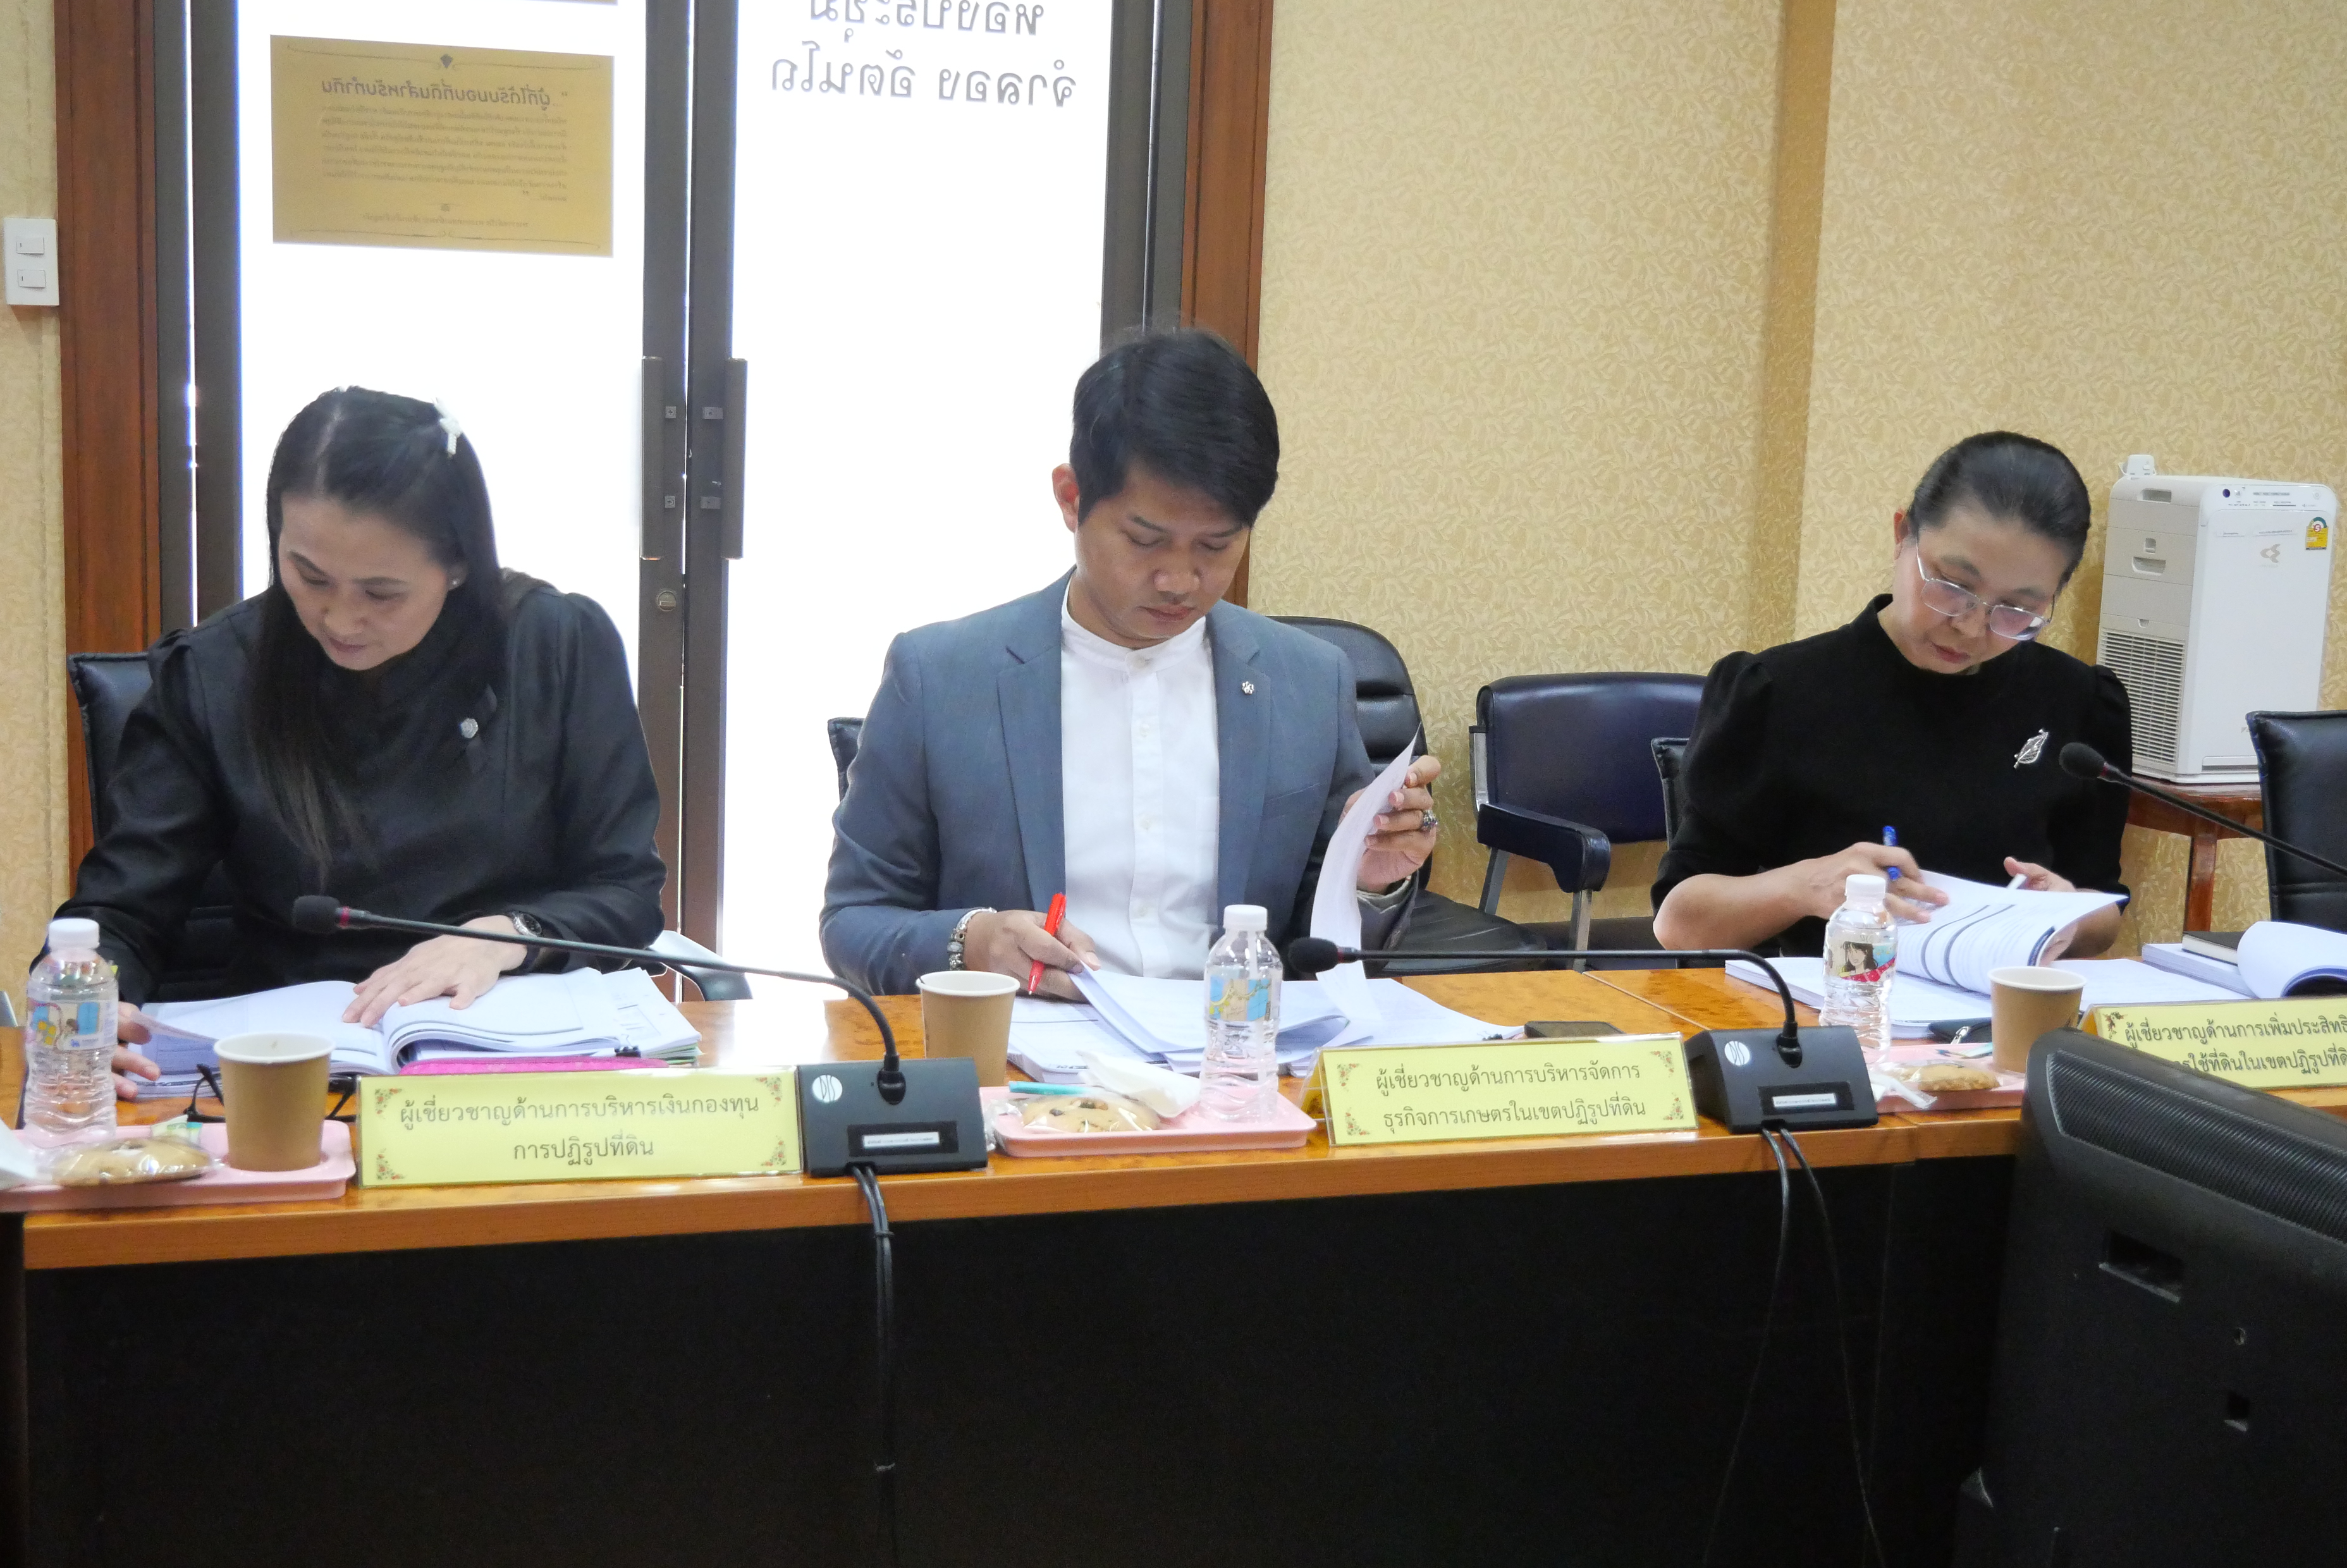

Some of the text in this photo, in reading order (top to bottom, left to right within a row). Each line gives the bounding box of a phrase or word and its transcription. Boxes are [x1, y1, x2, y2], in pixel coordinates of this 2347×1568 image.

[1376, 1060, 1640, 1097] ผู้เชี่ยวชาญด้านการบริหารจัดการ
[400, 1093, 759, 1130] ผู้เชี่ยวชาญด้านการบริหารเงินกองทุน
[1383, 1091, 1646, 1134] ธุรกิจการเกษตรในเขตปฏิรูปที่ดิน
[513, 1130, 654, 1166] การปฏิรูปที่ดิน
